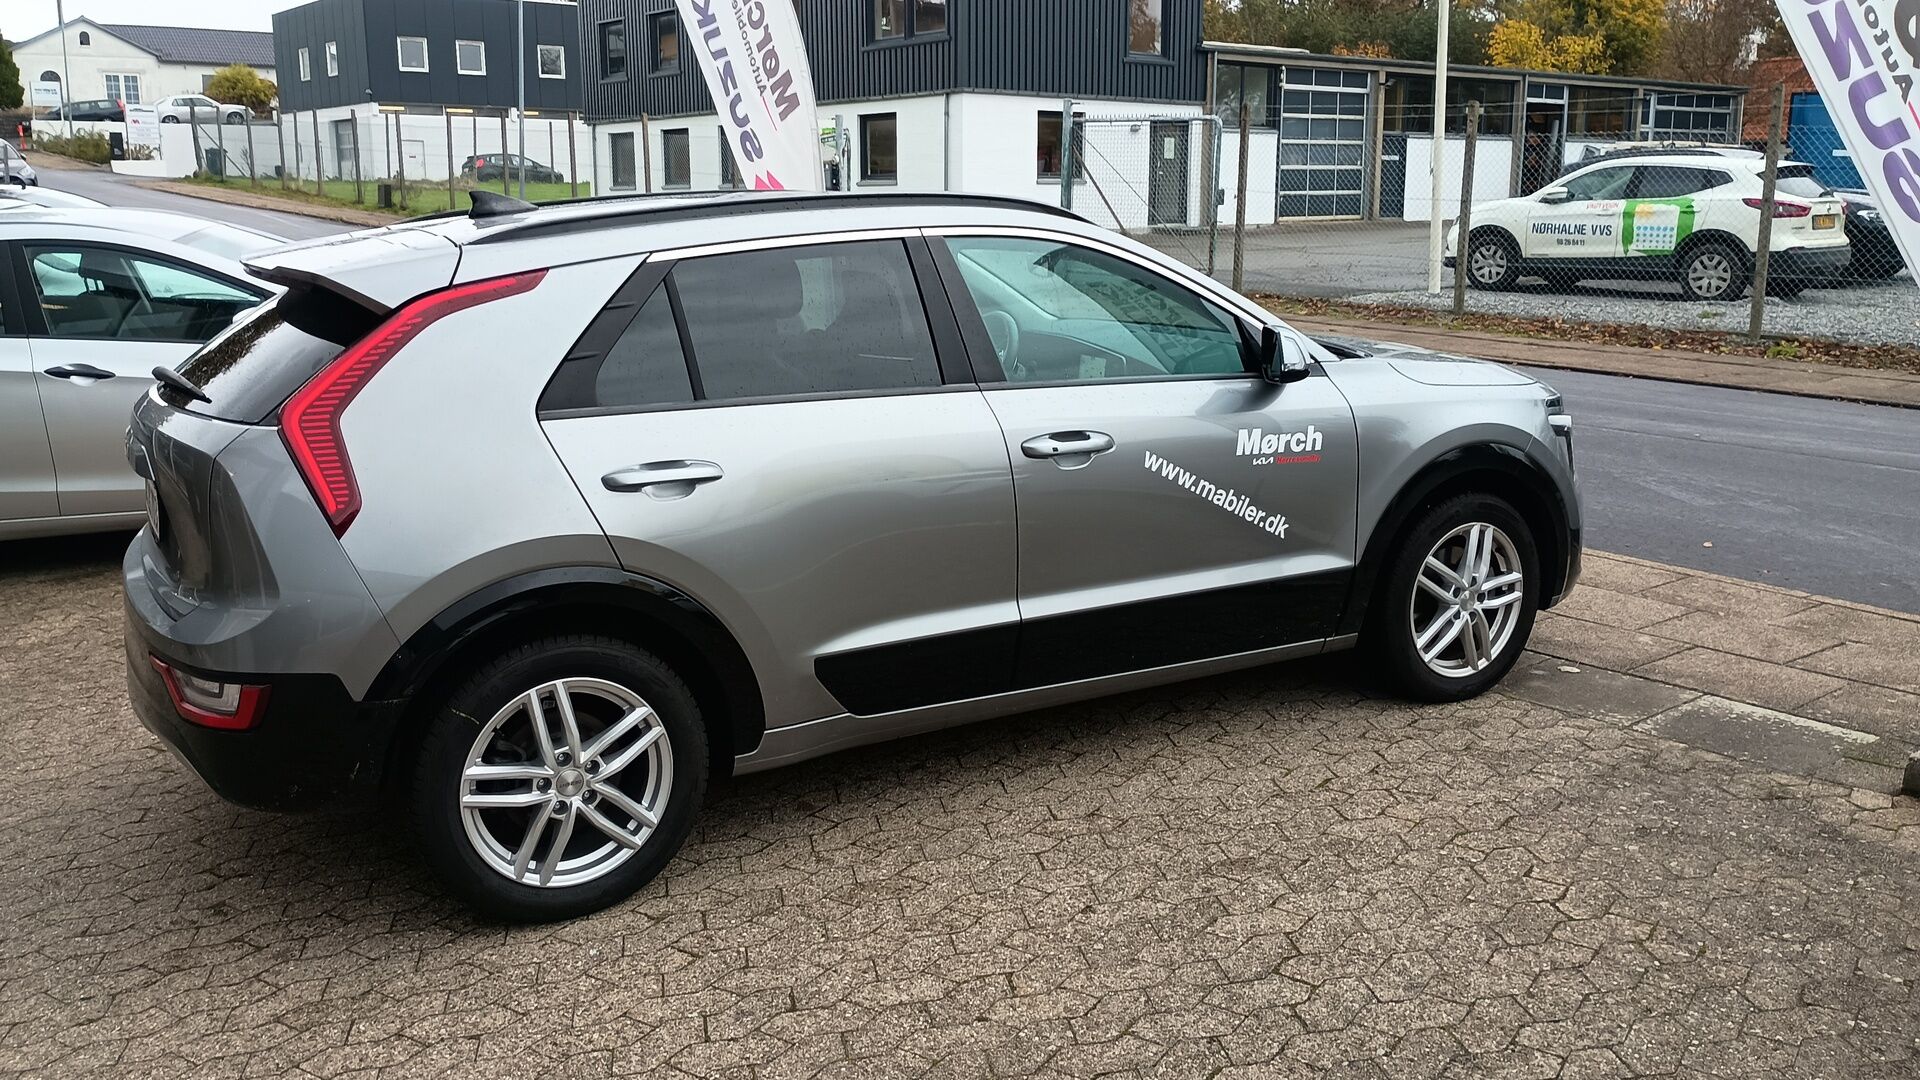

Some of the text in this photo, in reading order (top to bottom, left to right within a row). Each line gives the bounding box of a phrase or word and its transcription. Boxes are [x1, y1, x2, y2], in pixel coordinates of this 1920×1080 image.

[1531, 222, 1613, 237] NØRHALNE VVS
[1235, 424, 1324, 456] Mørch
[1143, 450, 1290, 540] www.mabiler.dk
